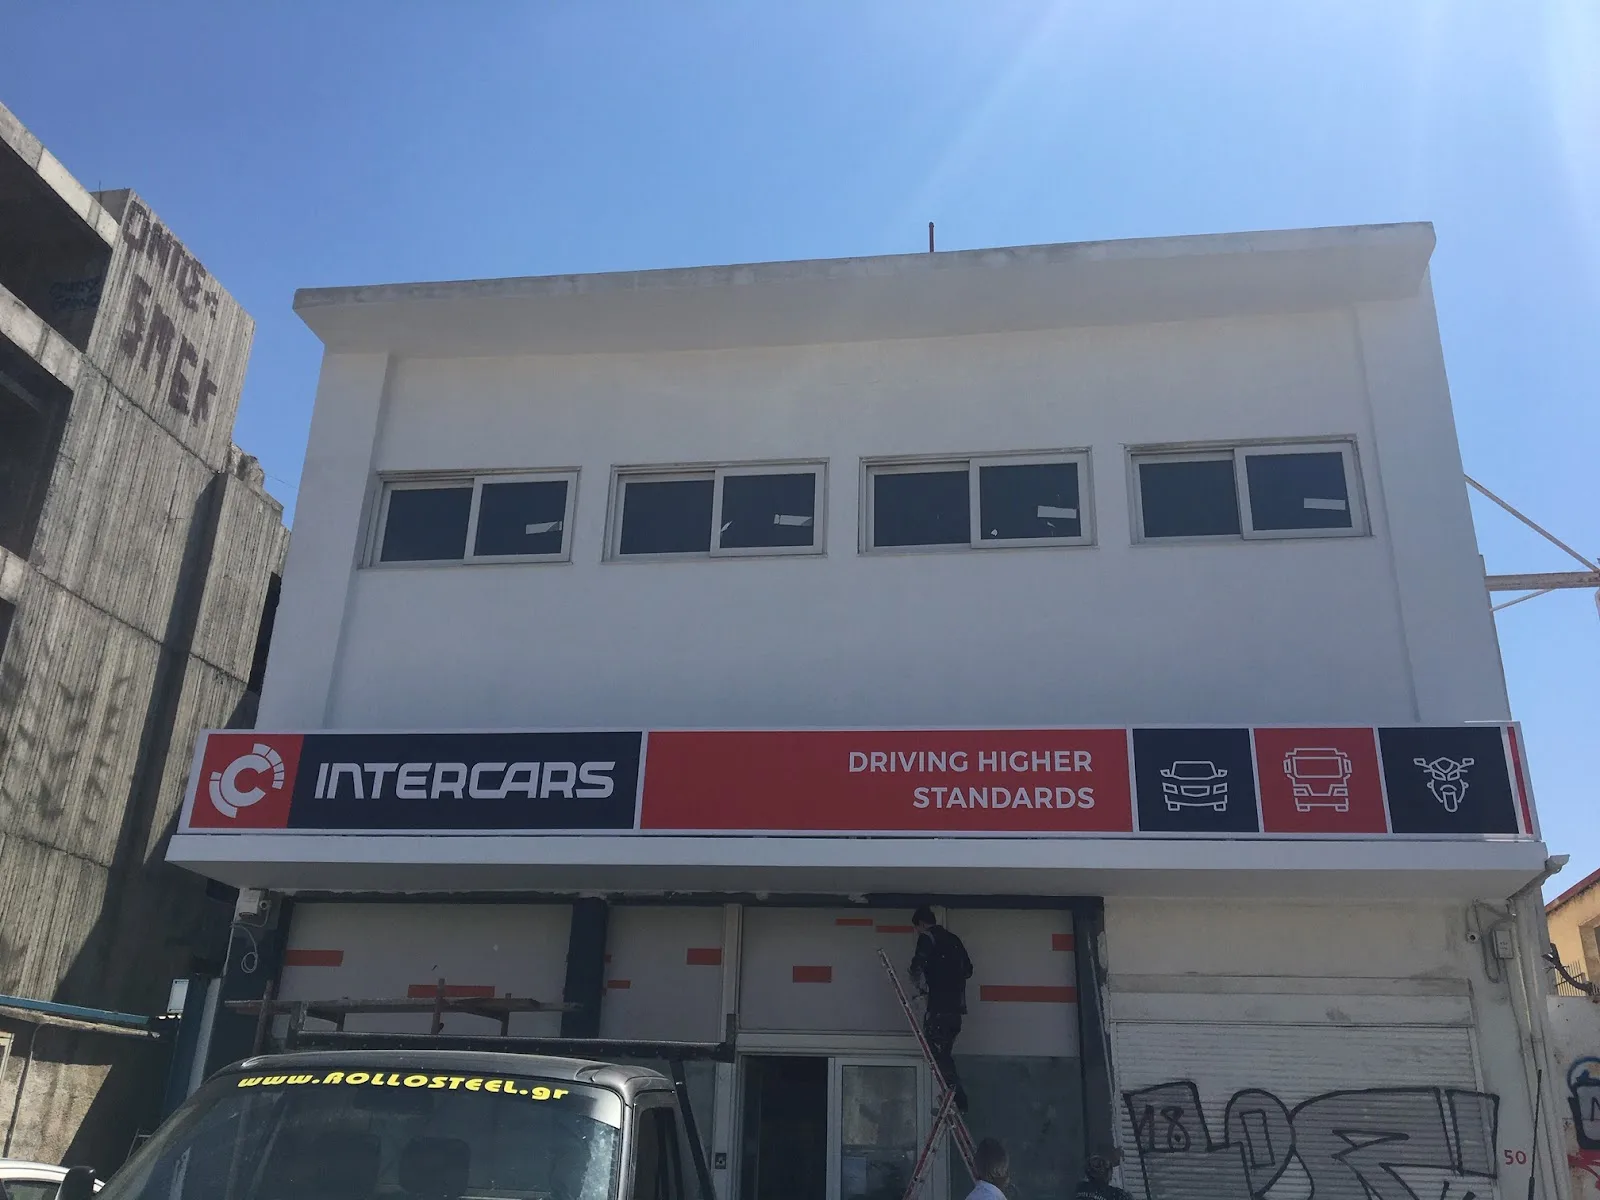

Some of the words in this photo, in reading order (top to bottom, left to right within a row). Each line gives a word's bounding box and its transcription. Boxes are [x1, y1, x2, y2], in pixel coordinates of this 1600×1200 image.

[848, 751, 969, 773] DRIVING
[978, 750, 1093, 772] HIGHER
[314, 761, 616, 799] INTERCARS
[912, 787, 1095, 809] STANDARDS
[1504, 1149, 1527, 1165] 50
